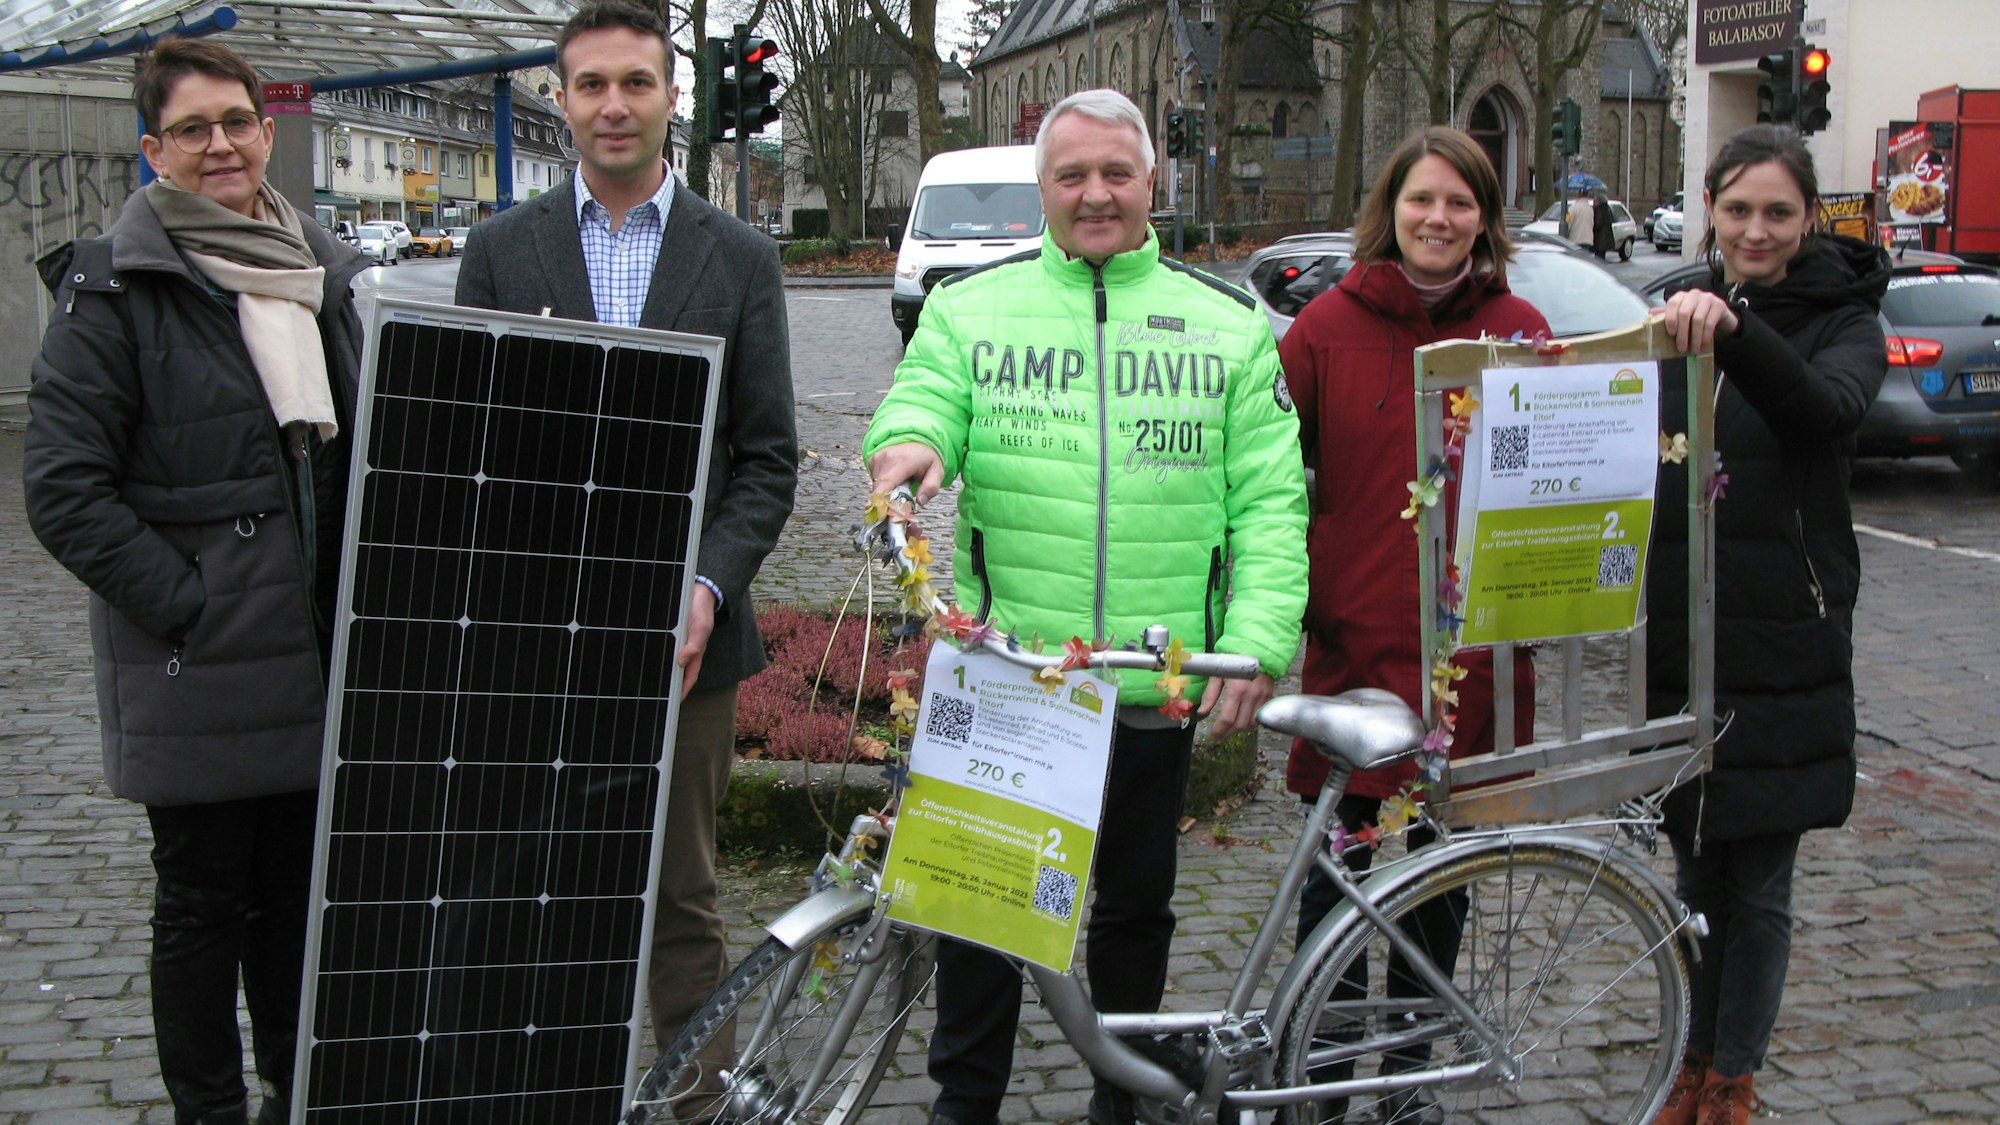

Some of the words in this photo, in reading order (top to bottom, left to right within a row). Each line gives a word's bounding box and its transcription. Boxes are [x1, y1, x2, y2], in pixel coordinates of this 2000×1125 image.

[1703, 0, 1791, 24] FOTOATELIER
[1708, 22, 1785, 46] BALABASOV
[1116, 321, 1166, 347] Blue
[1169, 323, 1219, 348] Label
[972, 340, 1084, 393] CAMP
[1115, 350, 1225, 398] DAVID
[1508, 382, 1531, 412] 1.
[1533, 391, 1600, 401] Förderprogramm
[1533, 401, 1582, 412] Rückenwind
[1591, 398, 1643, 409] Sonnenschein
[991, 402, 1044, 417] BREAKING
[1053, 407, 1086, 422] WAVES
[1011, 418, 1047, 431] WINDS
[1533, 412, 1555, 422] Eitorf
[1000, 434, 1032, 447] REEFS
[1041, 436, 1054, 449] OF
[1062, 439, 1080, 452] ICE
[1136, 419, 1202, 454] 25/01
[1124, 446, 1208, 484] Original
[1531, 462, 1541, 470] für
[1587, 458, 1598, 466] mit
[1530, 478, 1562, 496] 270
[1568, 477, 1582, 492] €
[1602, 510, 1626, 540] 2.
[1481, 541, 1494, 550] zur
[1496, 538, 1525, 549] Eitorfer
[1481, 585, 1494, 593] Am
[953, 665, 977, 693] 1.
[979, 698, 1005, 710] Eitorf
[979, 689, 1039, 705] Rückenwind
[1040, 698, 1047, 707] &
[1049, 700, 1101, 726] Sonnenschein
[972, 740, 983, 749] für
[1035, 759, 1046, 768] mit
[966, 758, 1005, 782] 270
[1010, 772, 1026, 788] €
[907, 808, 922, 817] zur
[924, 811, 958, 827] Eitorfer
[920, 797, 1044, 844] Öffentlichkeitsveranstaltung
[1042, 827, 1067, 863] 2.
[903, 856, 918, 866] Am
[918, 859, 968, 881] Donnerstag,
[982, 878, 1010, 893] Januar
[930, 873, 950, 885] 19:00
[957, 881, 979, 894] 20:00
[980, 887, 995, 898] Uhr
[1001, 894, 1027, 910] Online
